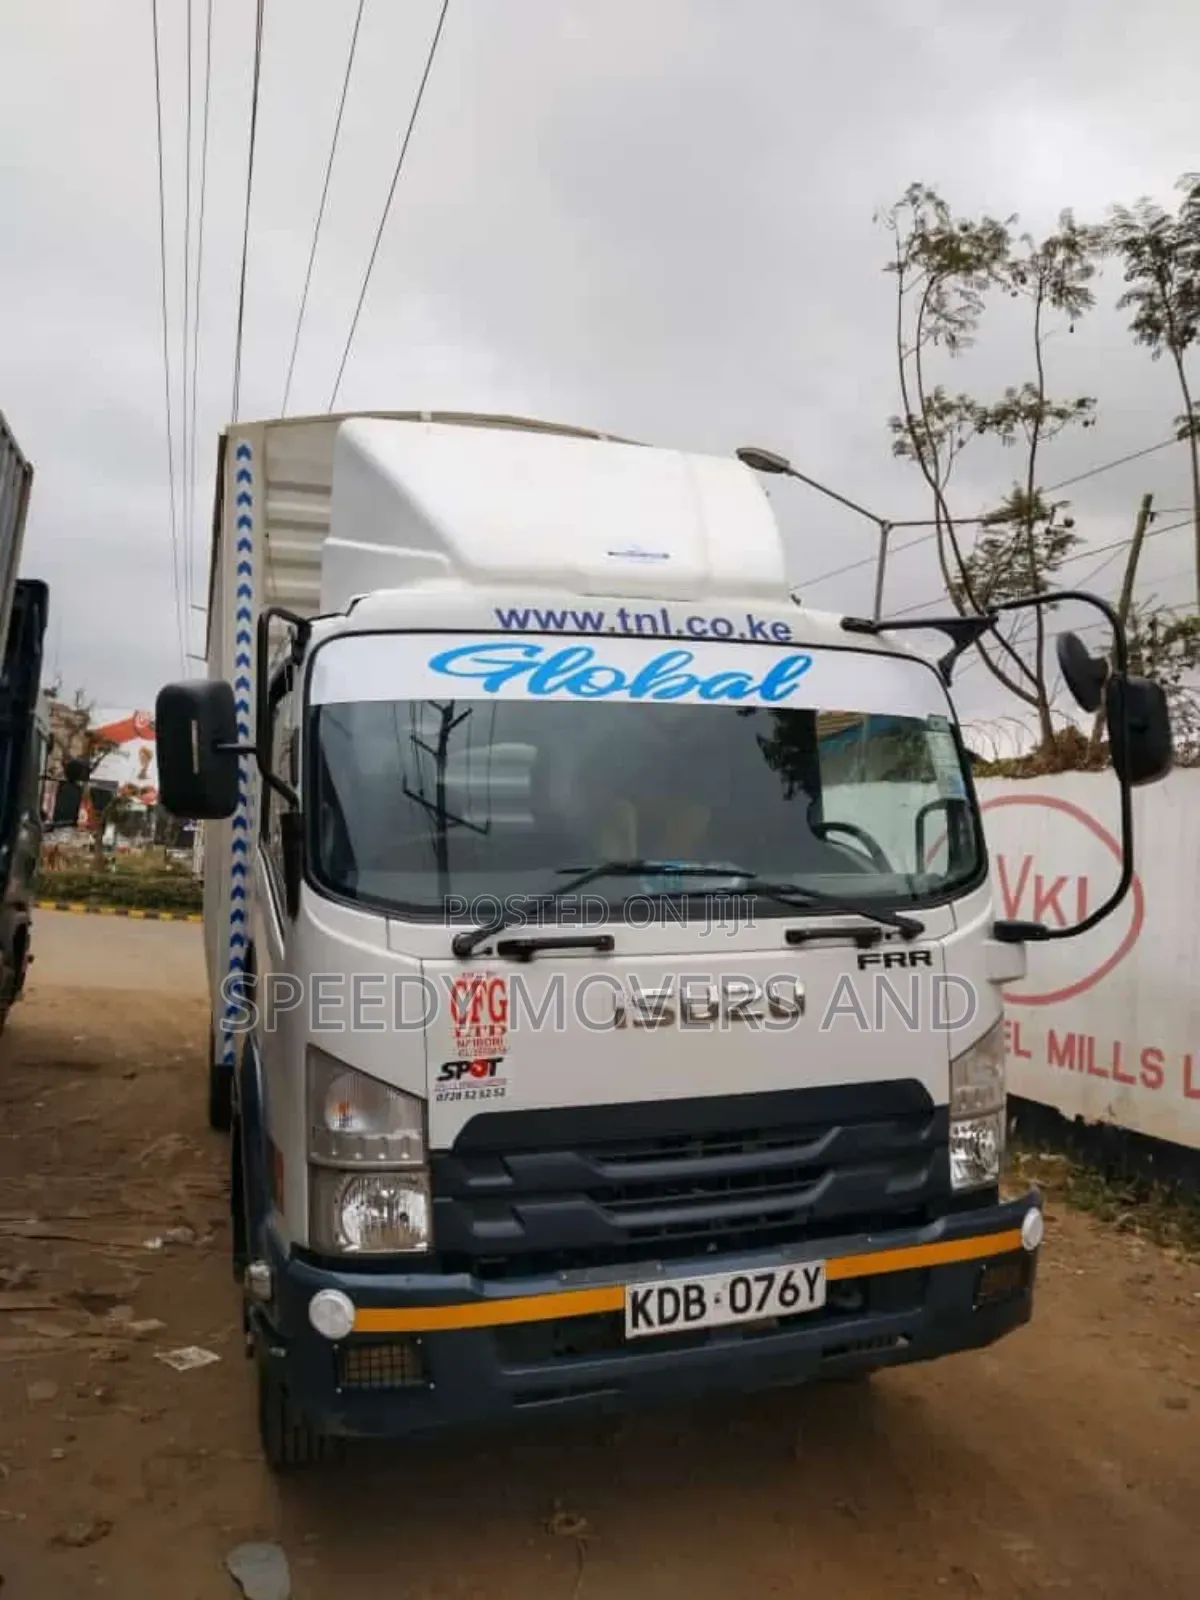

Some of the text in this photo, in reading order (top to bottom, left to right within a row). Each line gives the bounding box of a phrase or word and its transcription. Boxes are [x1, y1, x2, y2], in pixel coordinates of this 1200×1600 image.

[494, 606, 793, 641] www.tnl.co.ke
[428, 642, 813, 700] Global
[857, 949, 933, 971] FRR
[614, 981, 806, 1029] ISUZU
[436, 1057, 504, 1081] SPOT
[1047, 1029, 1165, 1090] MILLS
[631, 1266, 821, 1329] KDB 076Y
